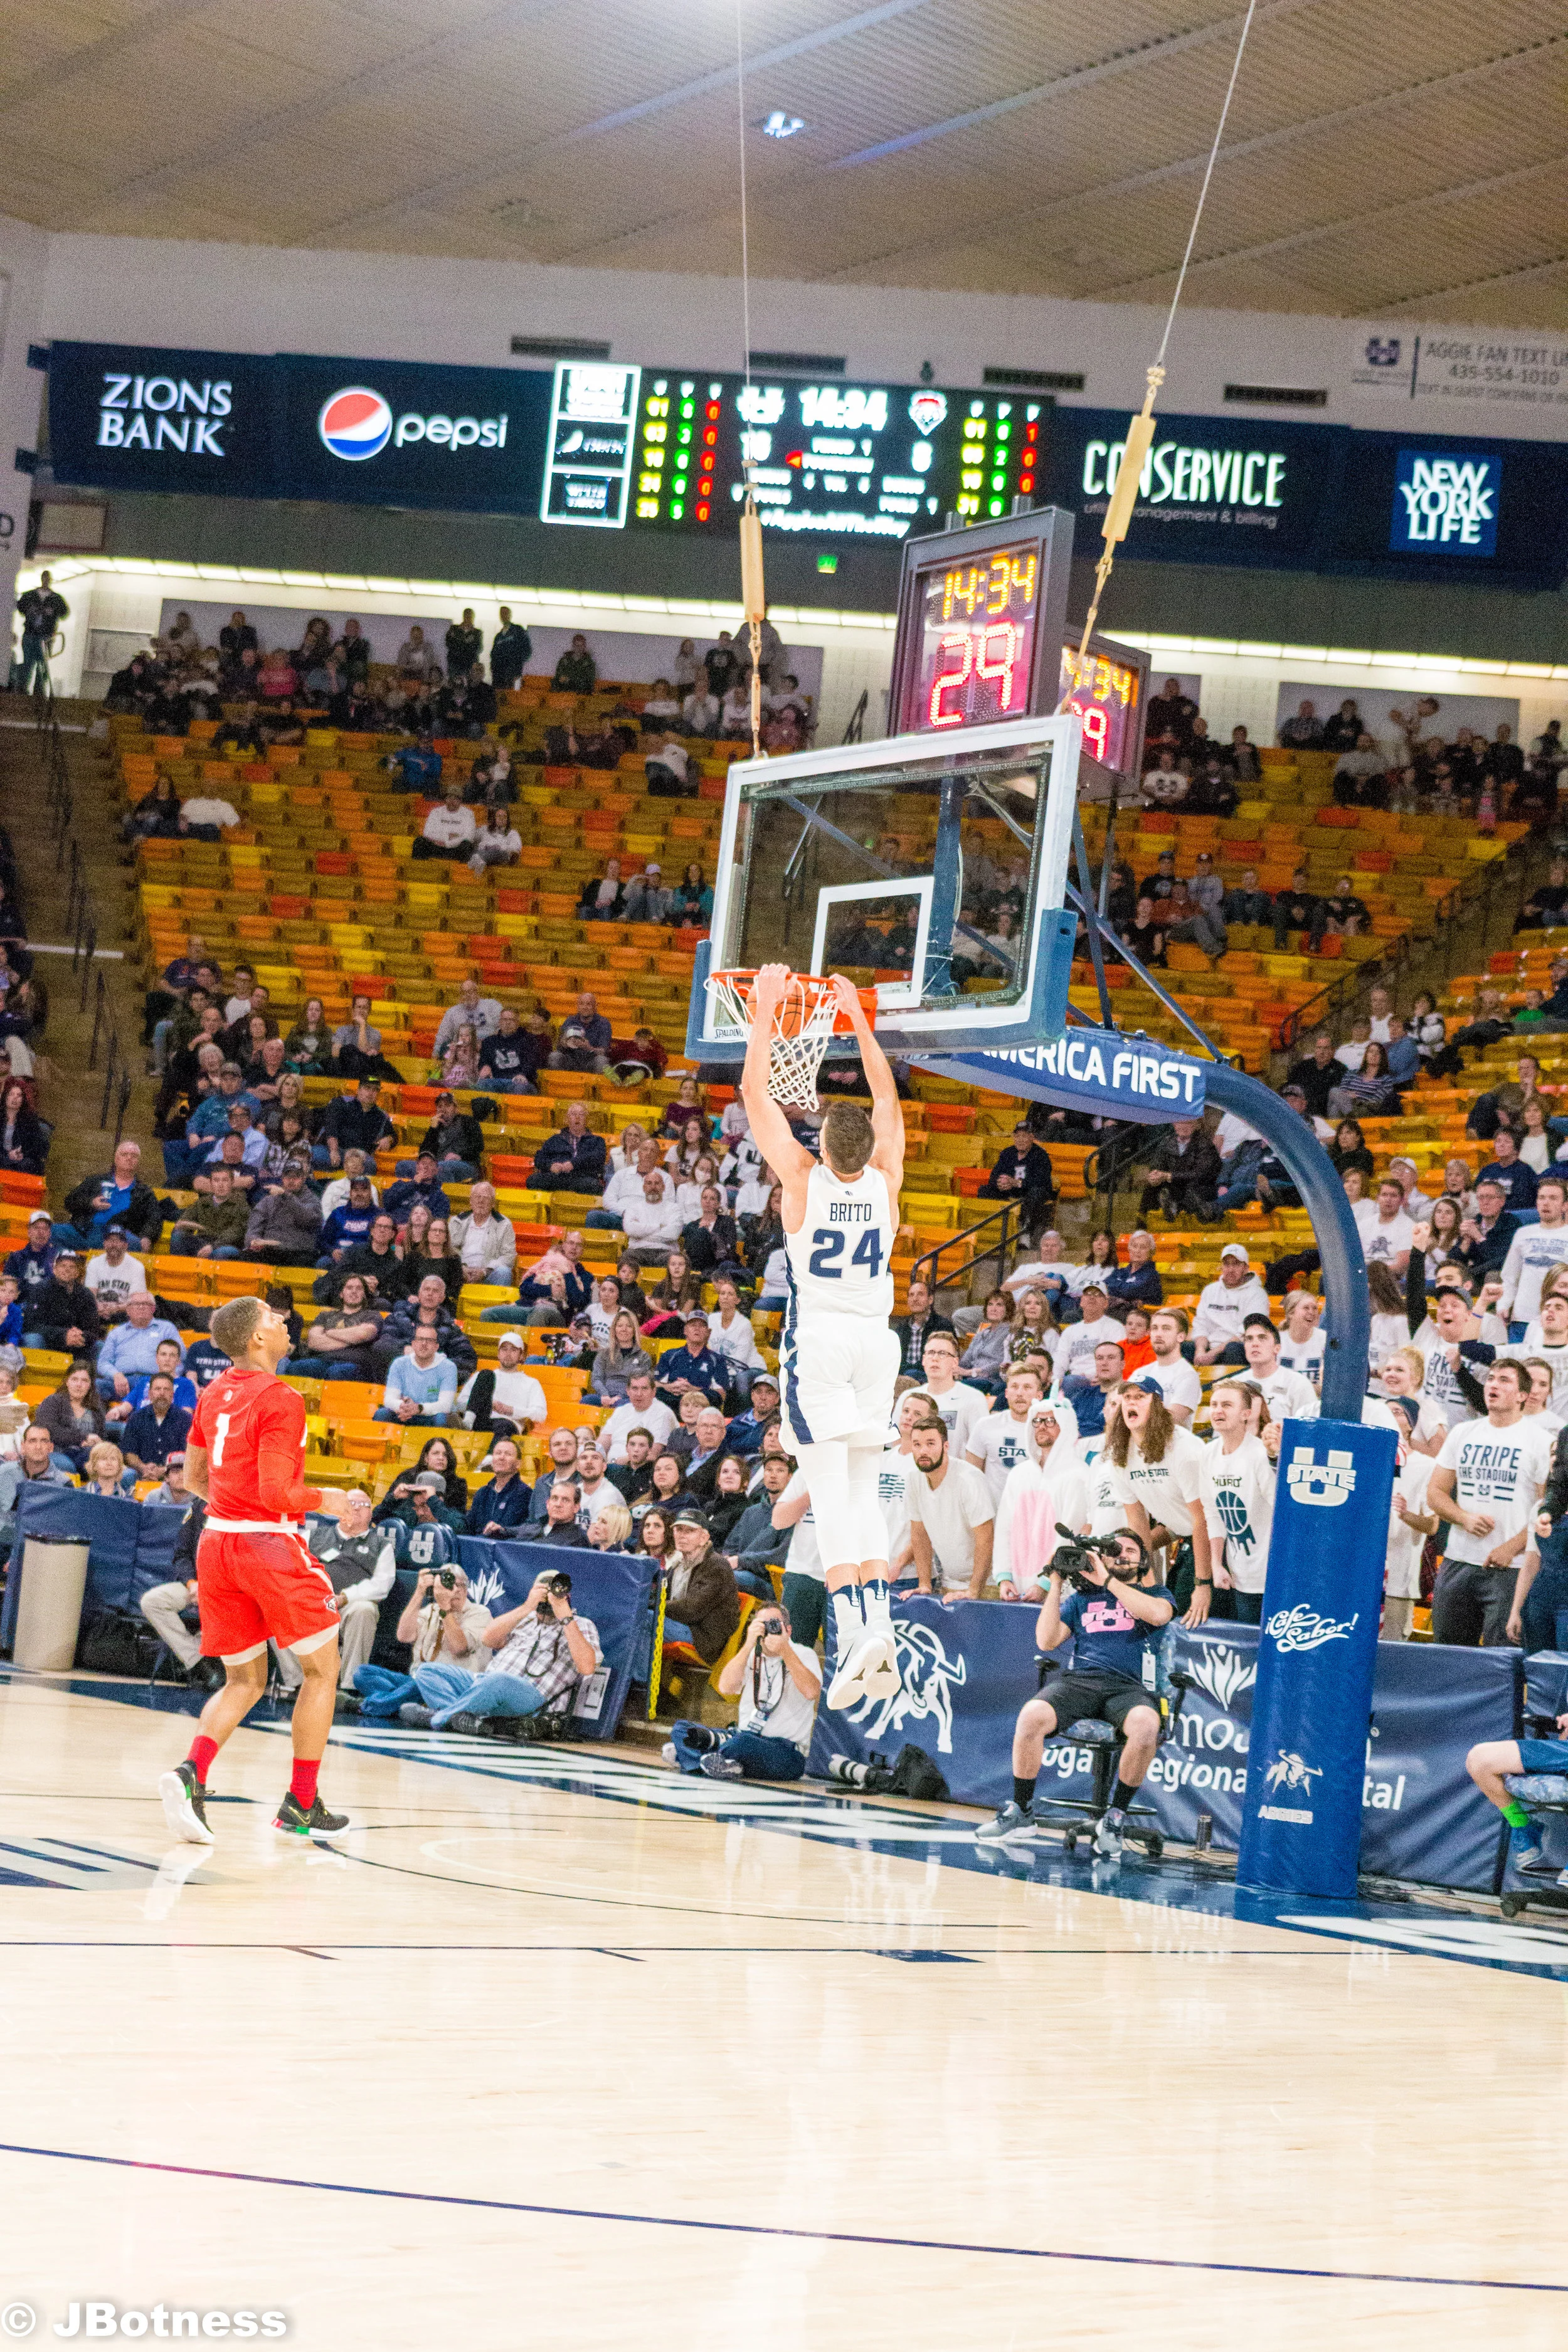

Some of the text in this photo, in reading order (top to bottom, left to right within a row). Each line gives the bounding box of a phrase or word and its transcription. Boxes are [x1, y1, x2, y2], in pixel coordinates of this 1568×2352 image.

[1514, 347, 1548, 364] TEXT
[1449, 364, 1560, 385] 435-554-1010
[100, 373, 233, 417] ZIONS
[799, 387, 888, 431] 14:34
[97, 411, 226, 457] BANK
[394, 413, 509, 451] pepsi
[1412, 458, 1490, 492] NEW
[1133, 508, 1217, 522] anagement
[1399, 482, 1495, 521] YORK
[1408, 512, 1481, 544] LIFE
[943, 553, 1036, 620] 14:34
[930, 620, 1017, 728] 29
[983, 1039, 1201, 1103] ERICA FIRST
[829, 1202, 872, 1222] BRITO
[809, 1227, 884, 1279] 24
[213, 1412, 231, 1466] 1
[999, 1446, 1027, 1458] STA
[1148, 1468, 1169, 1478] STATE
[1459, 1444, 1522, 1470] STRIPE
[1286, 1463, 1357, 1491] STATE
[1458, 1466, 1517, 1485] THE STADIUM
[1041, 1745, 1248, 1793] oga egiona
[1258, 1804, 1313, 1825] AGGIES
